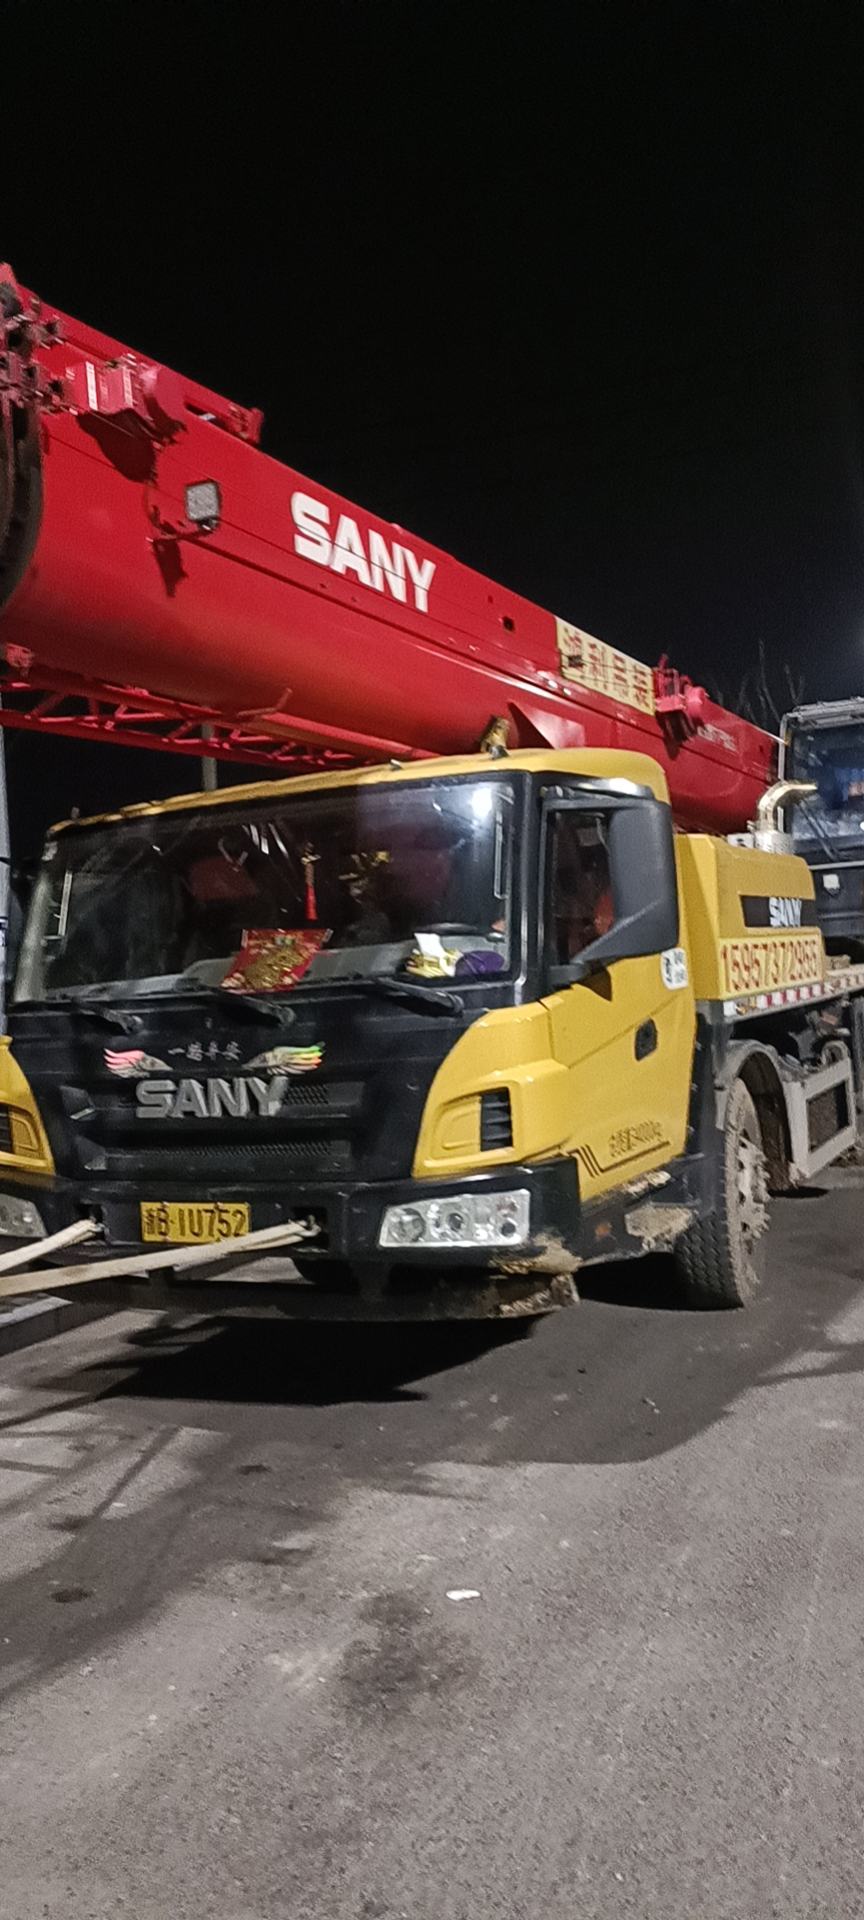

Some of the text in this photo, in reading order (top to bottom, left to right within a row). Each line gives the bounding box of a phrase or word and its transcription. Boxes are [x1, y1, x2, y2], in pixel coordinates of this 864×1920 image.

[290, 491, 436, 613] SANY
[768, 897, 802, 928] SANY
[136, 1076, 289, 1119] SANY
